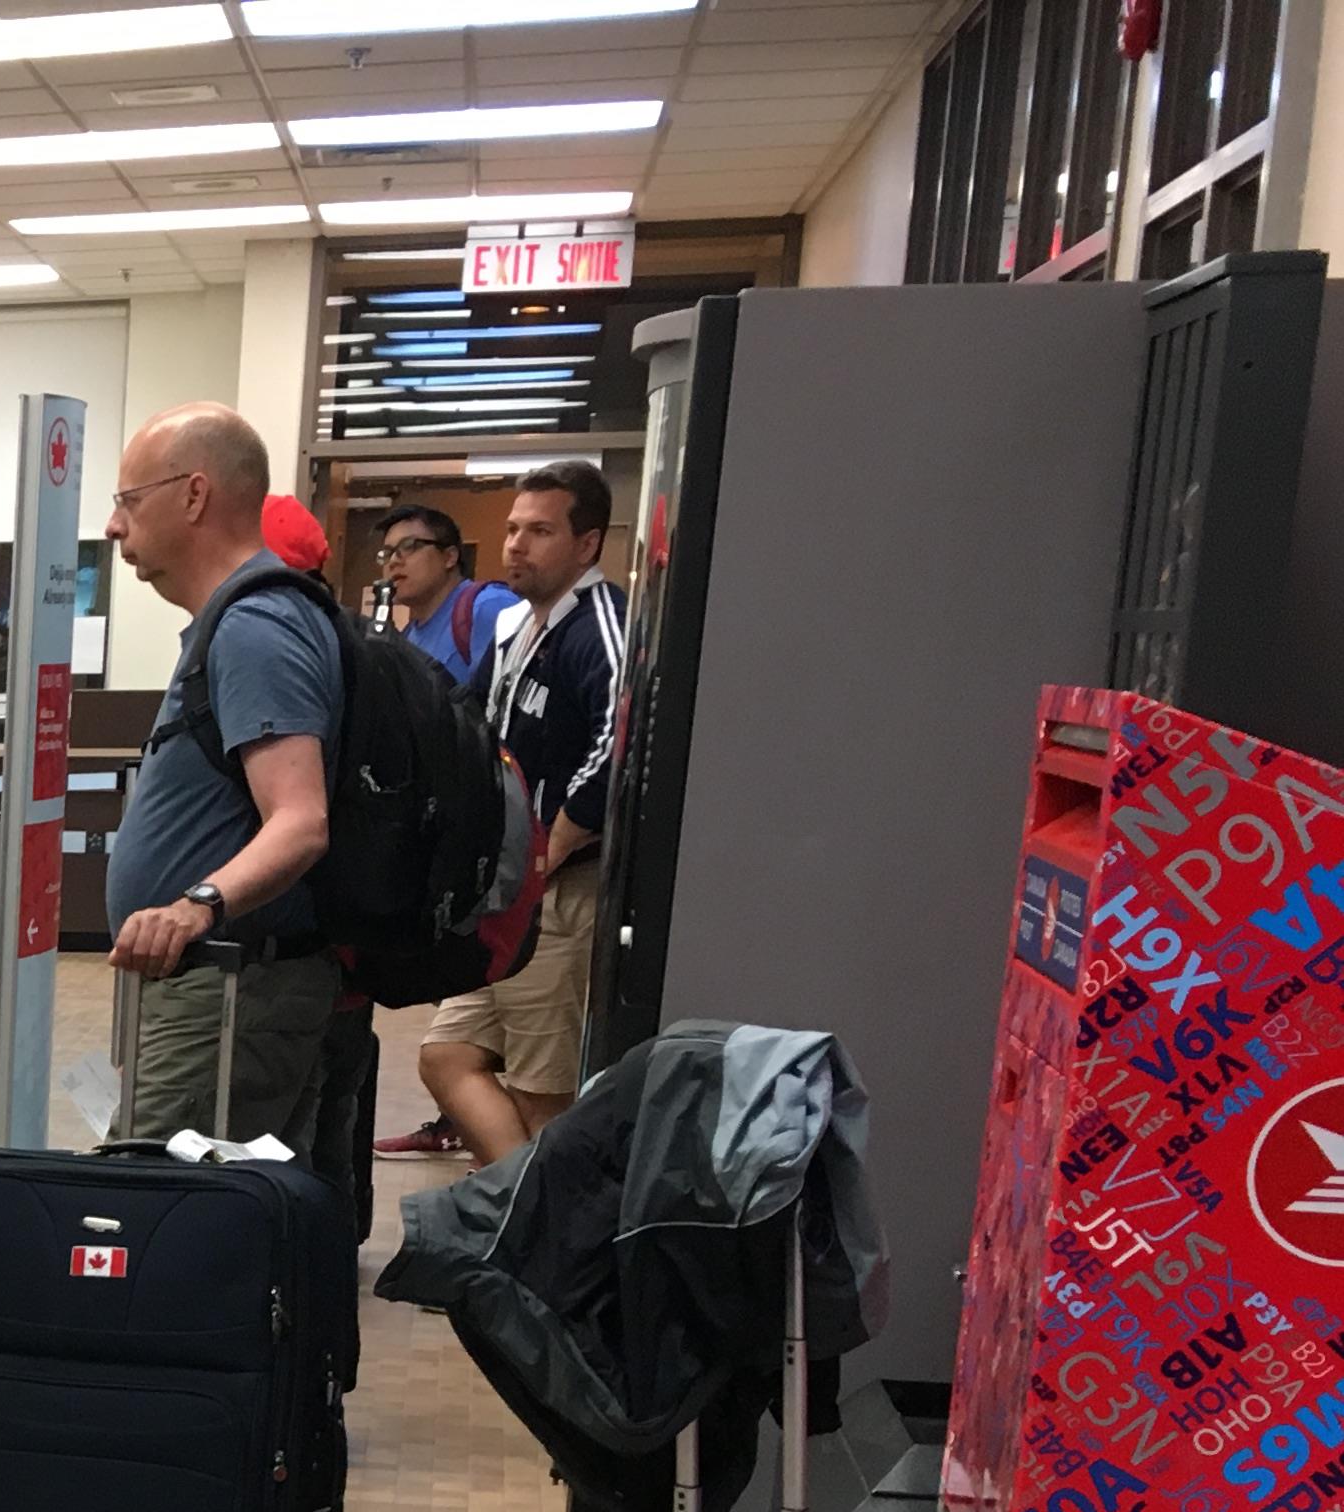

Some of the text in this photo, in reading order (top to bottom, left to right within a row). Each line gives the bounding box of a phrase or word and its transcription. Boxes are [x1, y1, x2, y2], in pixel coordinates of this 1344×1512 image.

[473, 245, 541, 287] EXIT
[1163, 773, 1344, 927] P9A
[1092, 884, 1222, 1015] H9X
[1128, 985, 1256, 1085] V6K
[1072, 1041, 1151, 1128] X1A
[1166, 1052, 1249, 1117] V1X
[1101, 1144, 1199, 1241] V7J
[1073, 1207, 1154, 1268] J5T
[1160, 1312, 1247, 1390] A1B
[1243, 1291, 1294, 1336] P3Y
[1058, 1351, 1179, 1466] G3N
[1240, 1343, 1305, 1408] P9A
